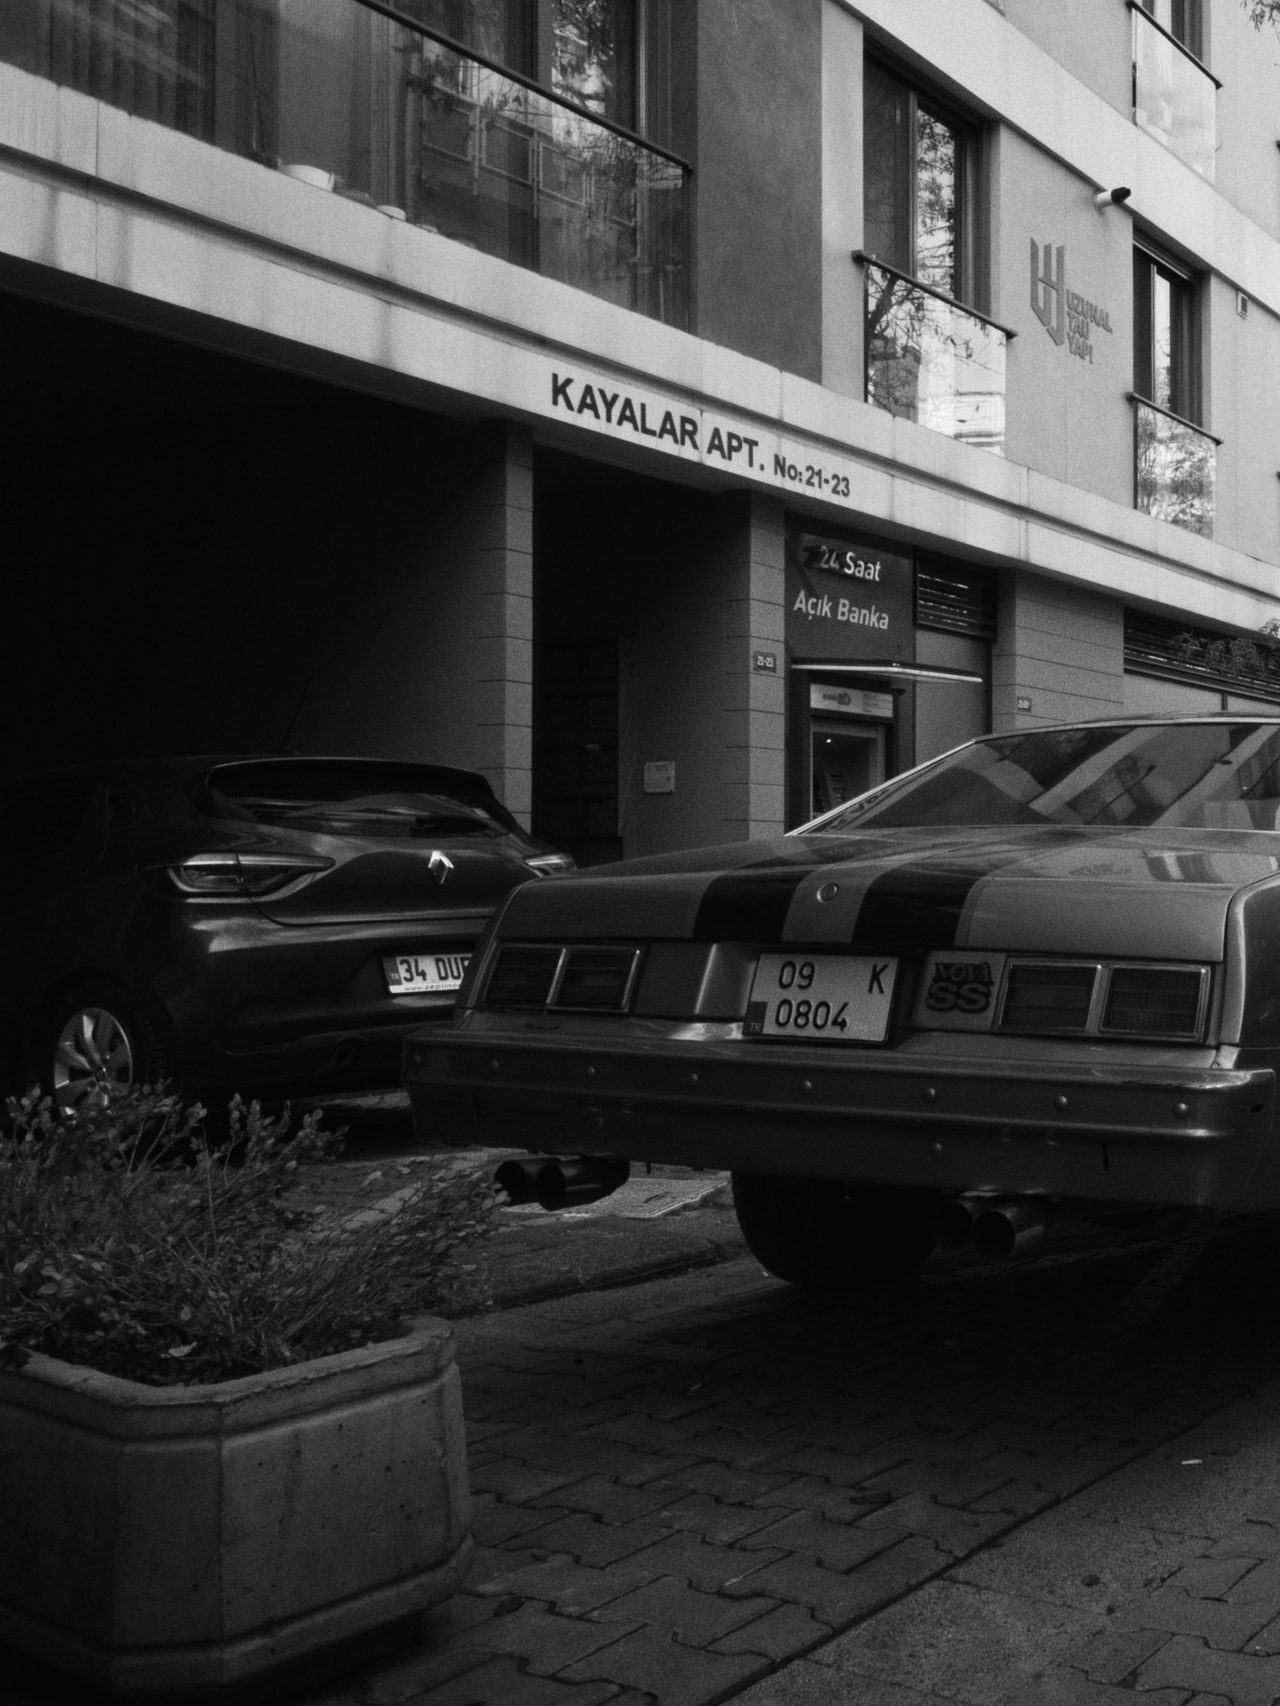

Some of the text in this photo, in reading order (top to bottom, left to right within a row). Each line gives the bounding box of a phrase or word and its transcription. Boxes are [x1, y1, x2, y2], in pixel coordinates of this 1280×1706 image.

[1066, 331, 1094, 365] YAPI
[551, 372, 699, 451] KAYALAR
[706, 427, 765, 471] APT.
[820, 545, 881, 582] 24 Saat
[793, 589, 889, 630] Açık Banka
[399, 958, 427, 982] 34
[778, 960, 890, 994] 09 K
[404, 983, 461, 992] www.zeplinc
[926, 981, 990, 1012] SS
[749, 1022, 762, 1034] TR
[775, 998, 849, 1031] 0804
